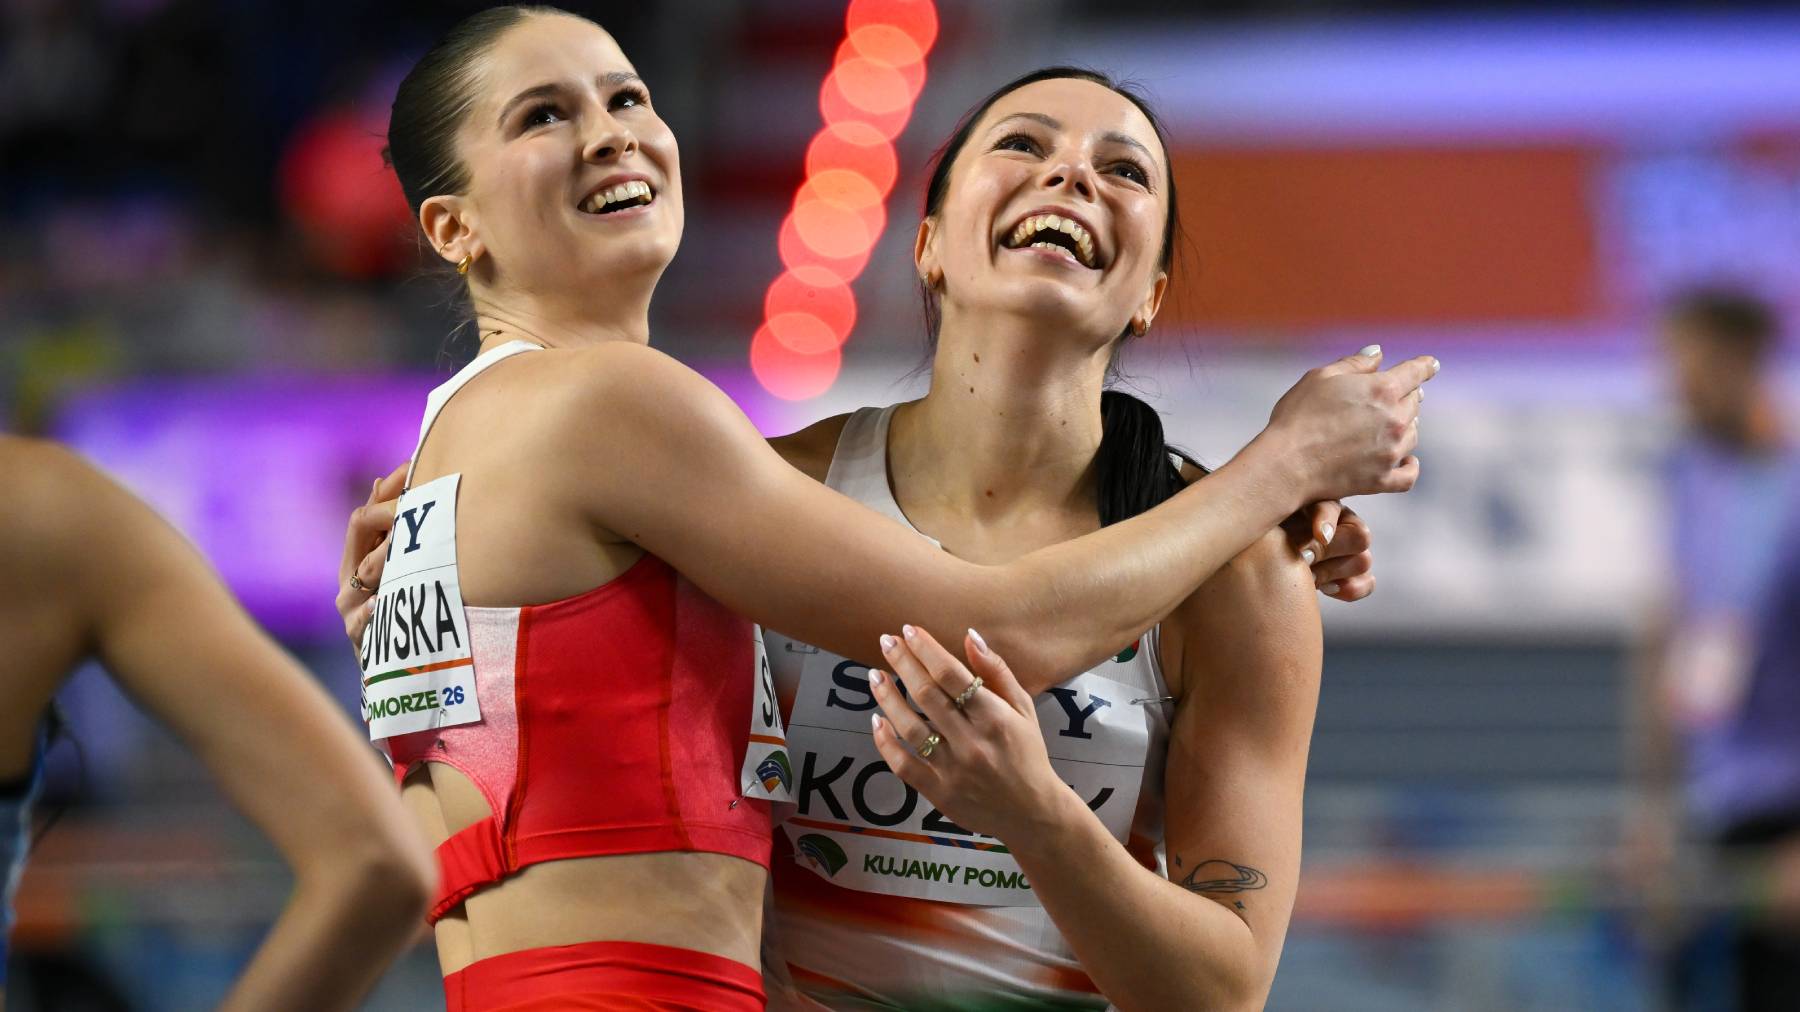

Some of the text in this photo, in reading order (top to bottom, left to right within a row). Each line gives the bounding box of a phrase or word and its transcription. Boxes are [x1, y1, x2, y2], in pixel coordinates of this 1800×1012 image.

[442, 686, 464, 706] 26
[826, 660, 1112, 739] SY
[863, 854, 960, 883] KUJAWY
